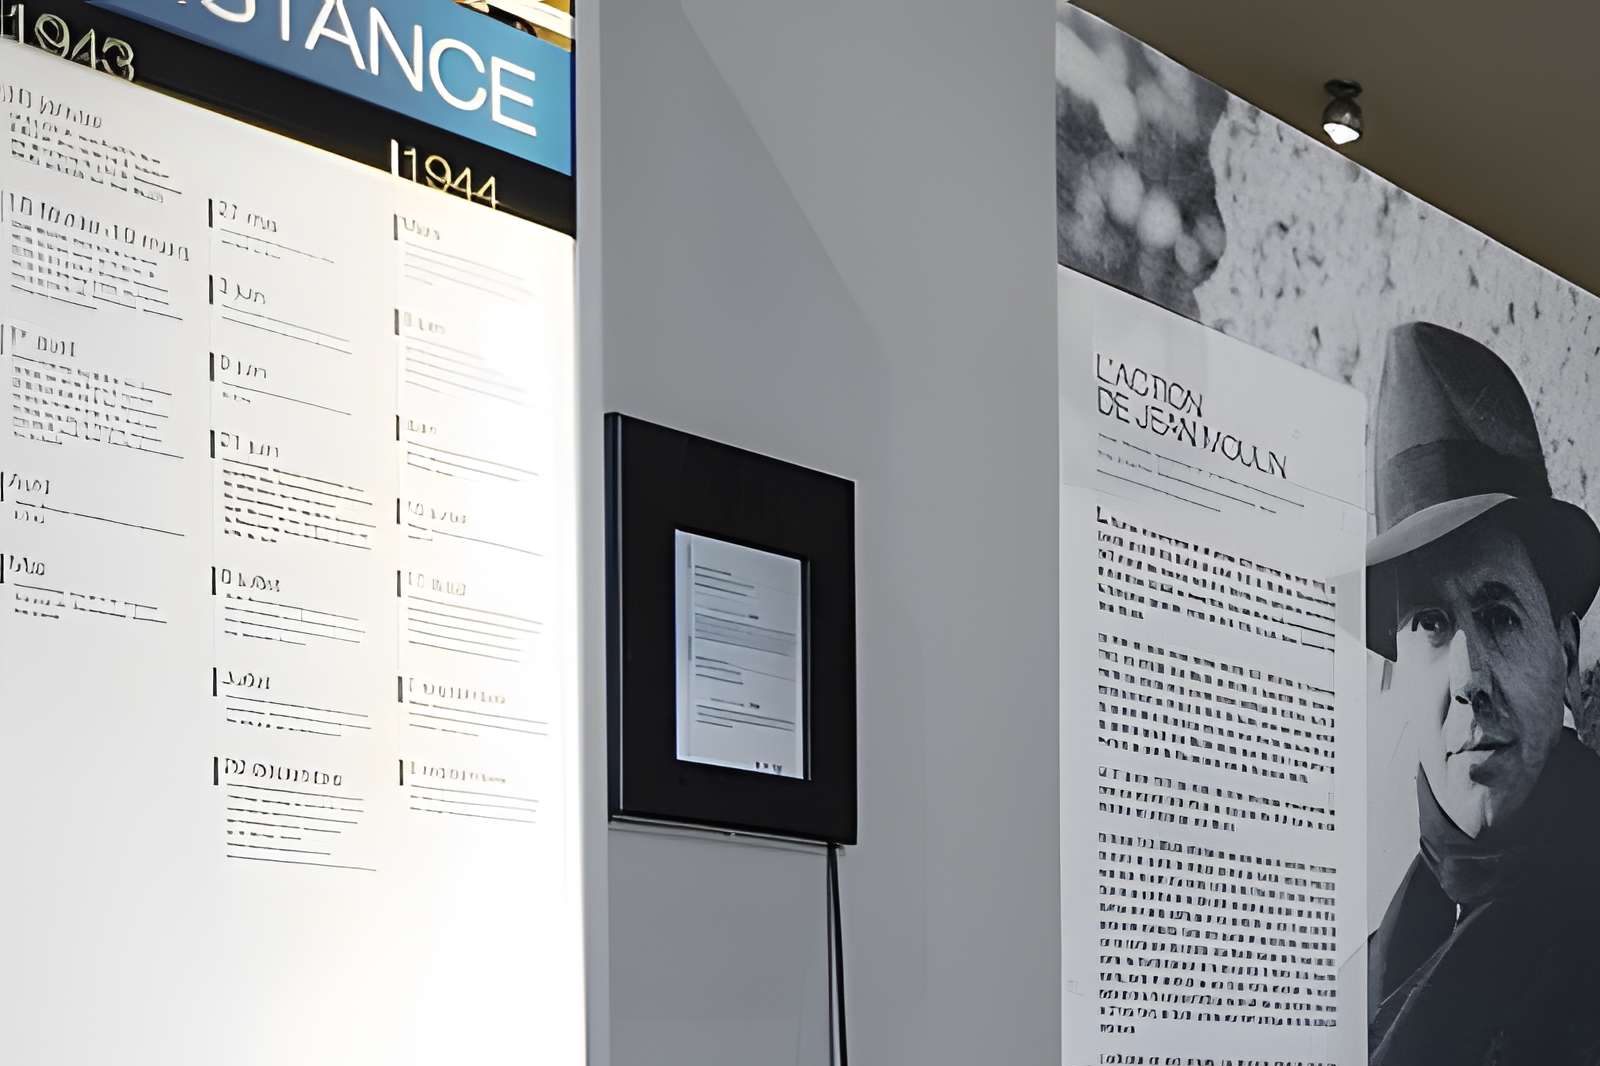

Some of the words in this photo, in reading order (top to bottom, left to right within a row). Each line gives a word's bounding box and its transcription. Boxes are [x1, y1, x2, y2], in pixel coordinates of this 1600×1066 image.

[403, 147, 497, 210] 1944
[1096, 353, 1203, 418] L'ACTION
[1097, 385, 1131, 424] DE
